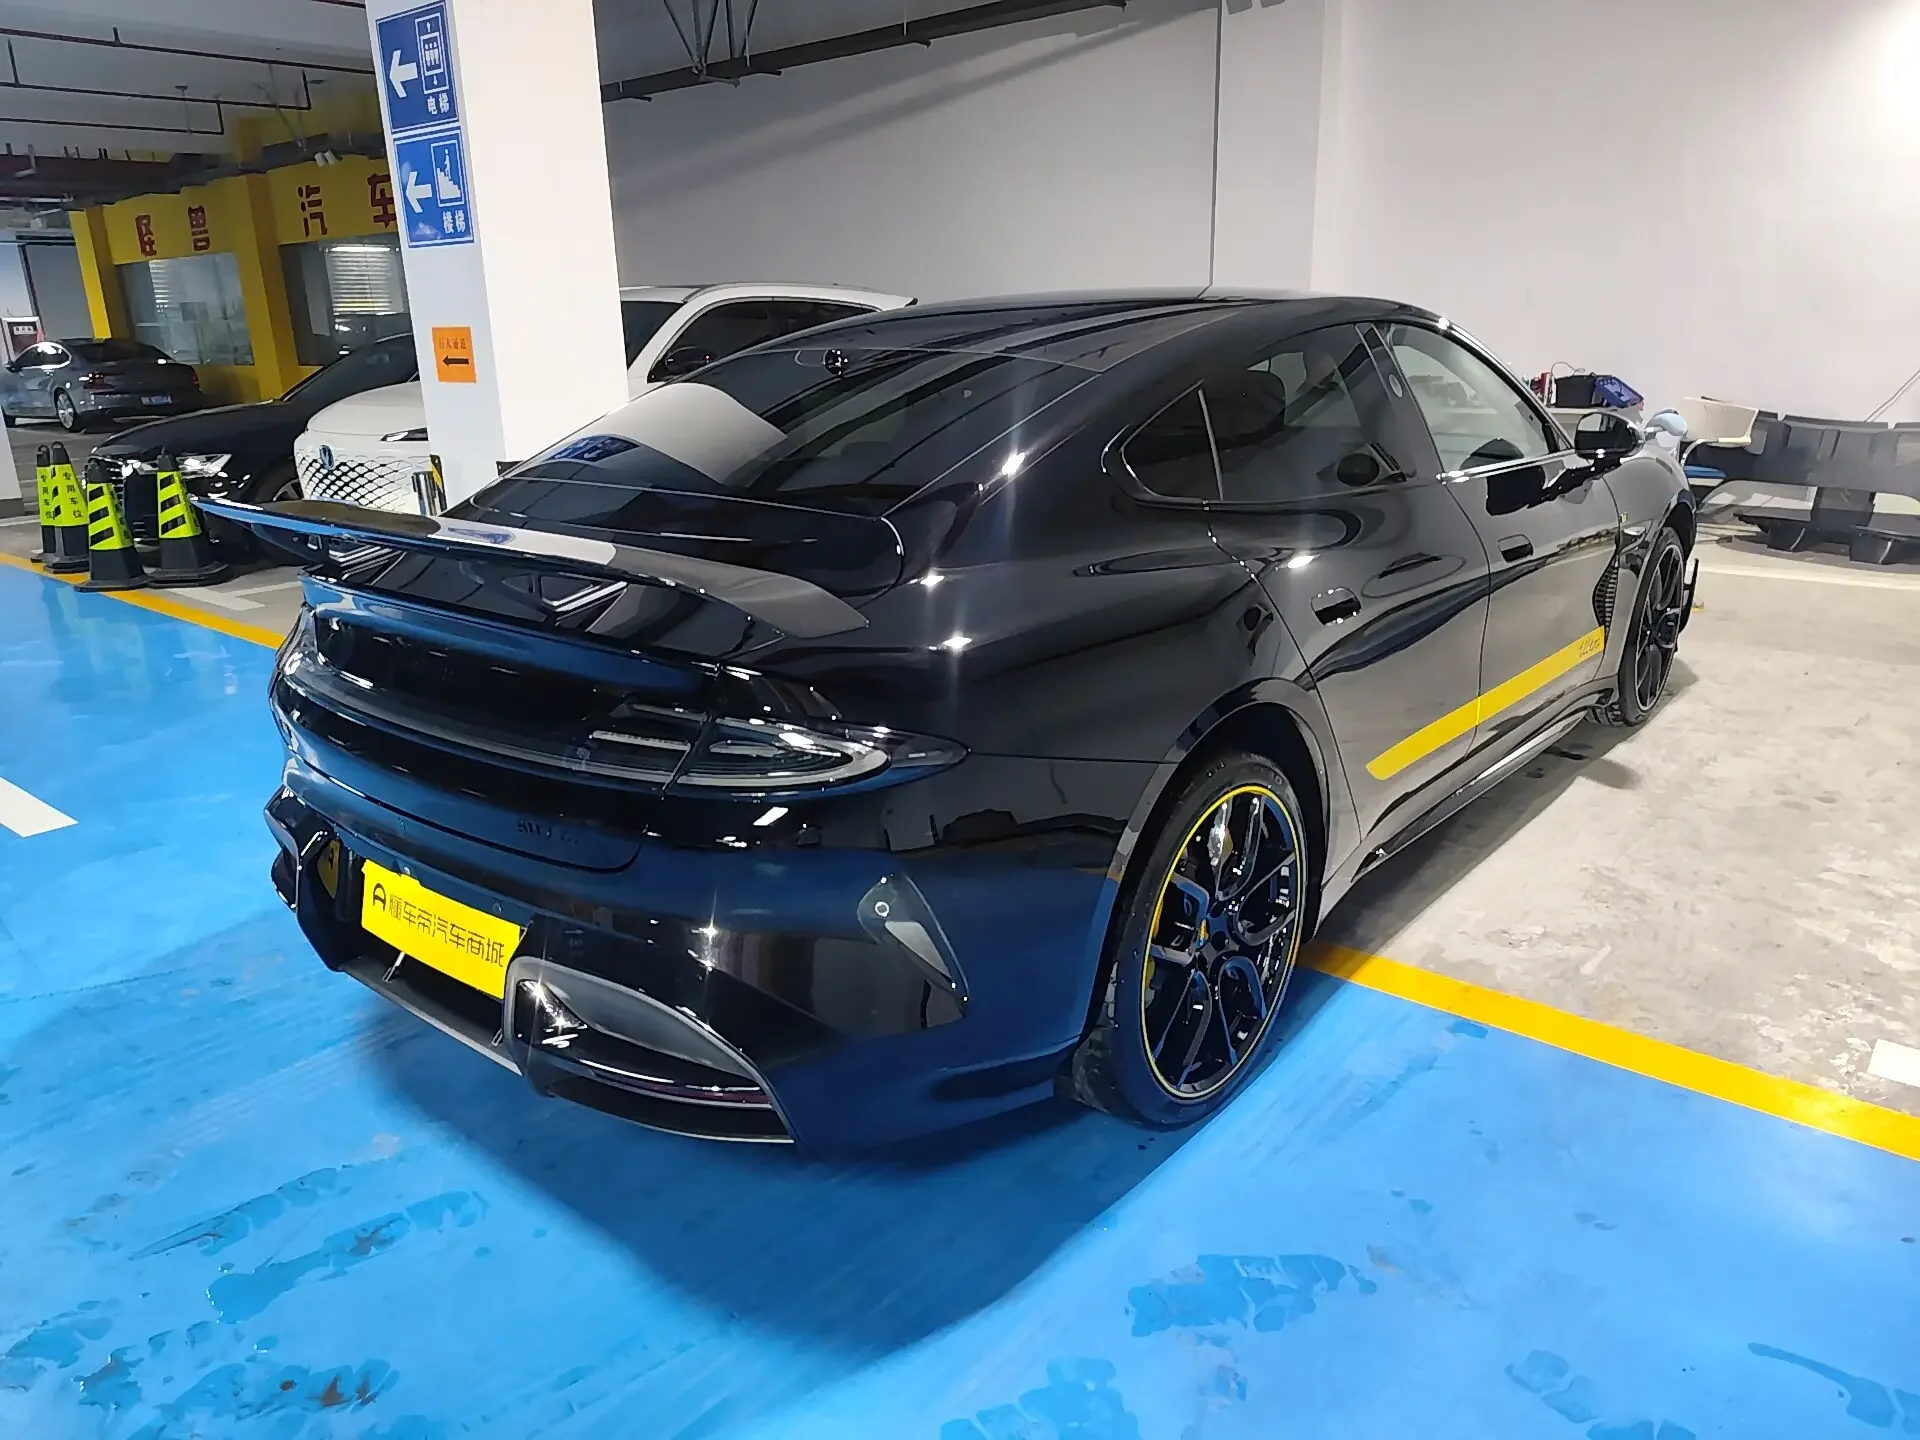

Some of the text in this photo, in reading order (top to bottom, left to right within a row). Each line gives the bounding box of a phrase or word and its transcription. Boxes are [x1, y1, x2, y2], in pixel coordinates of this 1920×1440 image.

[427, 93, 450, 115] 电梯
[442, 209, 466, 234] 楼梯
[63, 471, 83, 519] 专用车位
[389, 893, 505, 968] 懂车帝汽车商城
